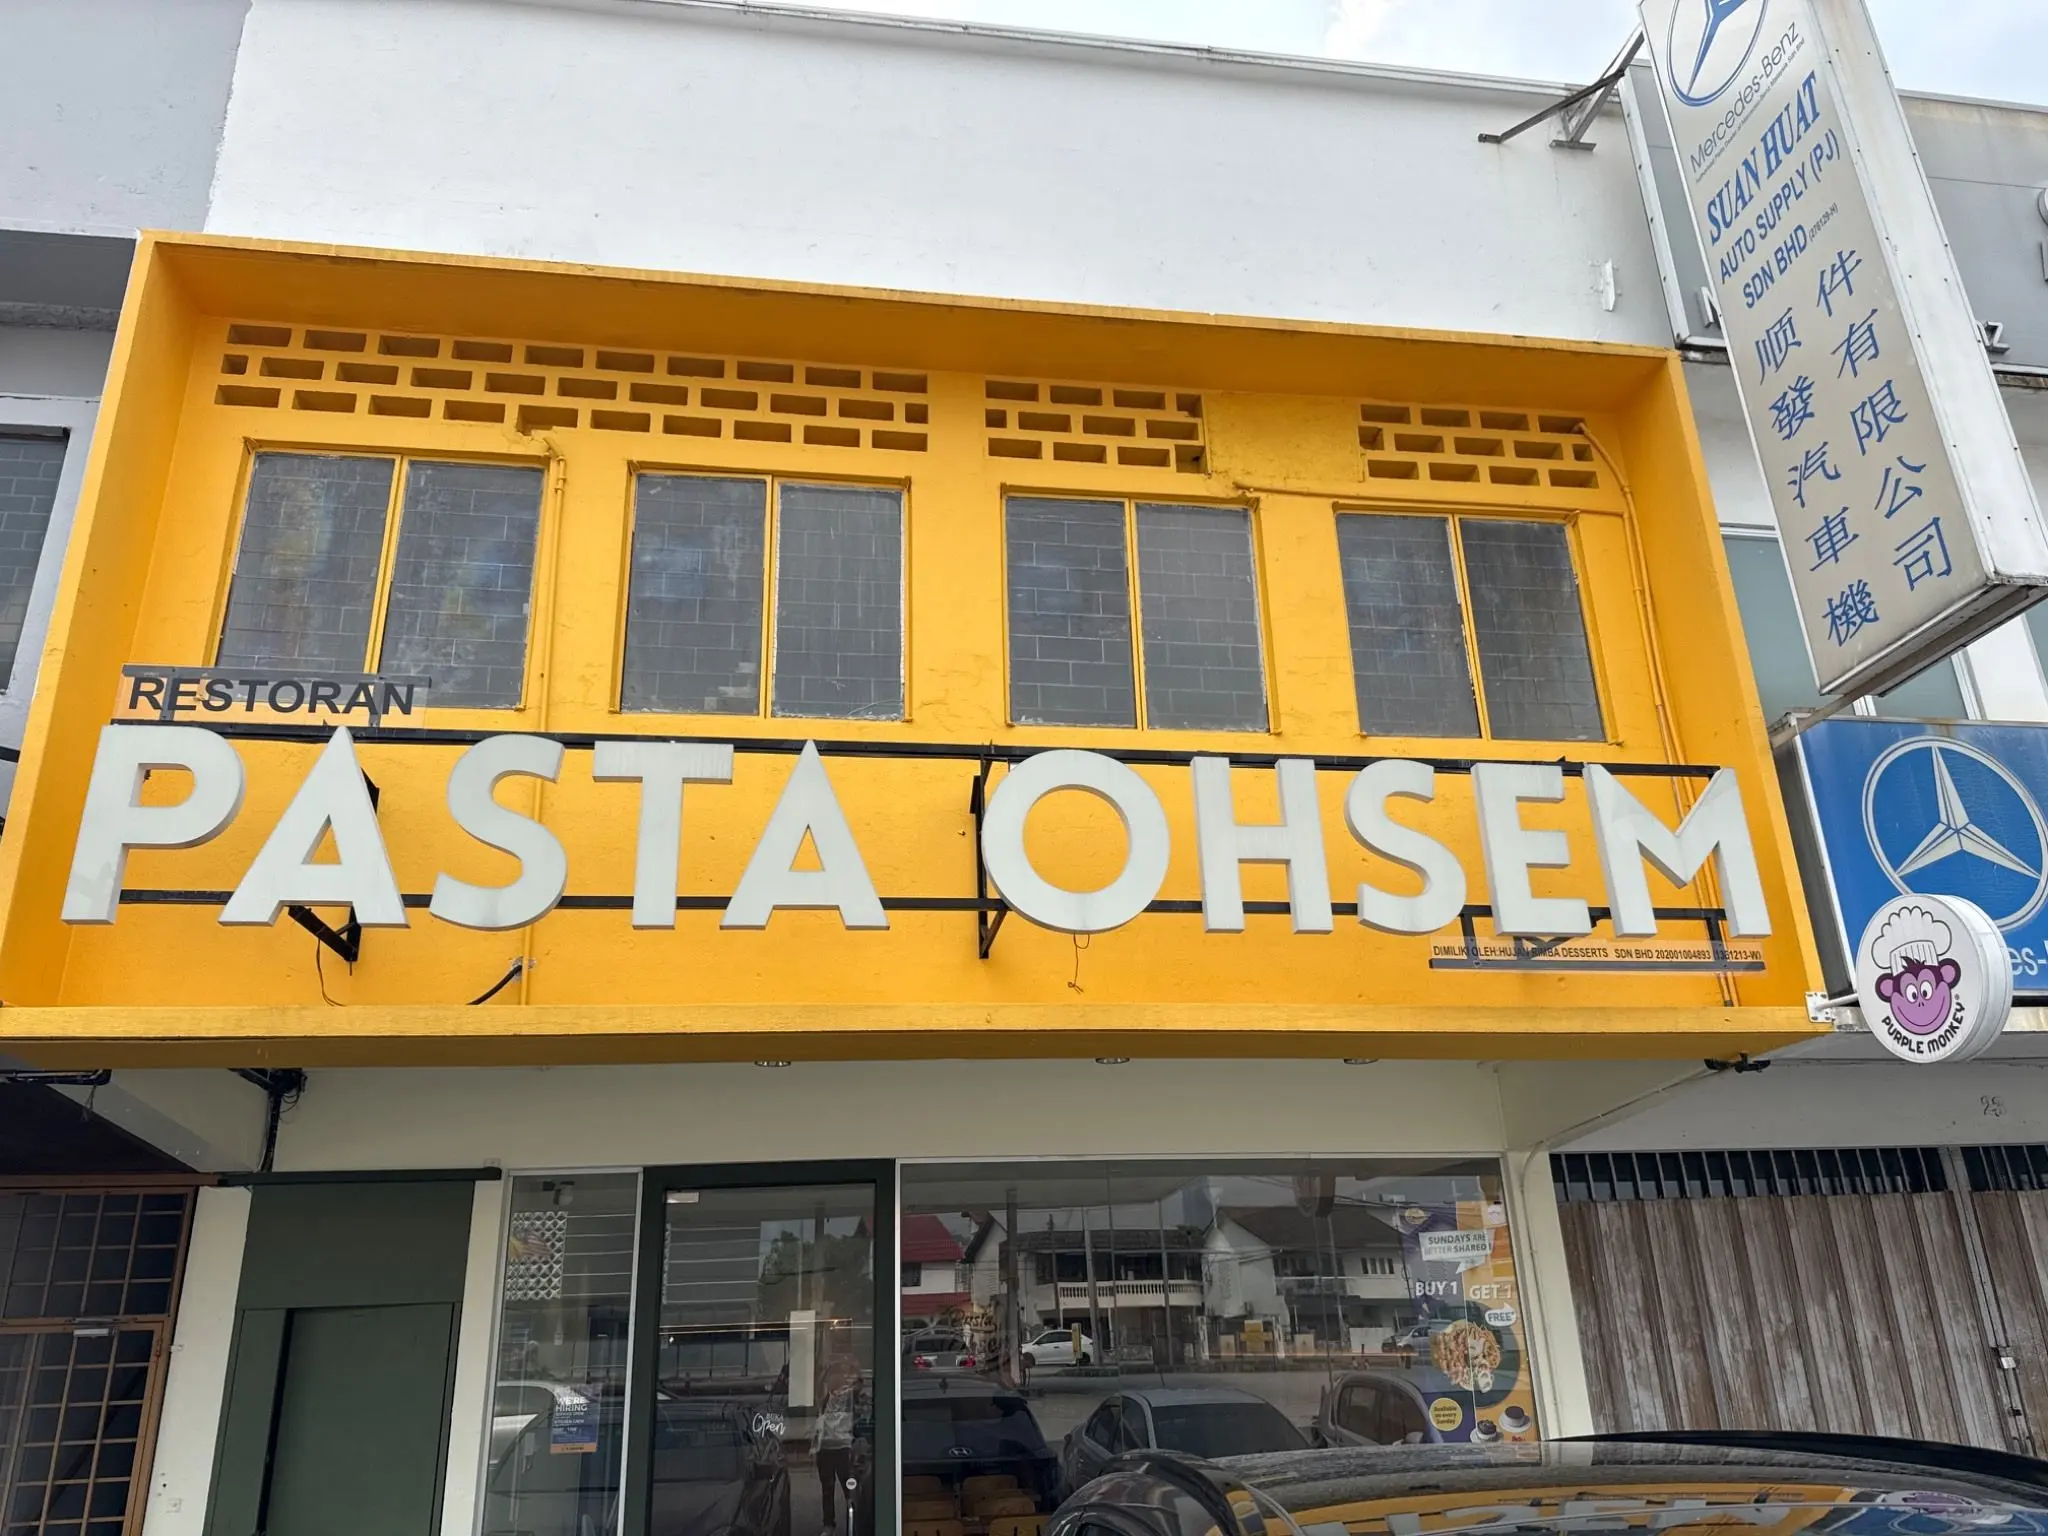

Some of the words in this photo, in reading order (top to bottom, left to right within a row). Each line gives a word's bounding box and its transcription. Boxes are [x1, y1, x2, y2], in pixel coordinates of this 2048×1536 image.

[1690, 22, 1799, 173] Mercedes-Benz
[1706, 147, 1761, 246] SUAN
[1760, 70, 1820, 179] HUAT
[1719, 228, 1755, 285] AUTO
[1755, 161, 1808, 240] SUPPLY
[1810, 128, 1840, 184] (PJ)
[1743, 260, 1775, 309] SDN
[1774, 223, 1808, 276] BHD
[1816, 249, 1954, 592] 件有限公司
[128, 676, 417, 716] RESTORAN
[61, 724, 890, 932] PASTA
[981, 749, 1772, 938] OHSEM
[1561, 947, 1608, 959] DESSERTS
[1614, 948, 1633, 959] SDN
[1634, 949, 1654, 959] BHD
[1881, 1015, 1924, 1054] PURPLE
[1927, 1001, 1965, 1053] MONKEY
[1428, 1233, 1471, 1245] SUNDAYS
[1472, 1233, 1486, 1242] ARE
[1415, 1281, 1446, 1296] BUY
[1450, 1281, 1458, 1295] 1
[1469, 1284, 1500, 1299] GET
[1503, 1284, 1512, 1299] 1
[555, 1404, 588, 1412] HIRING
[752, 1412, 786, 1438] Open
